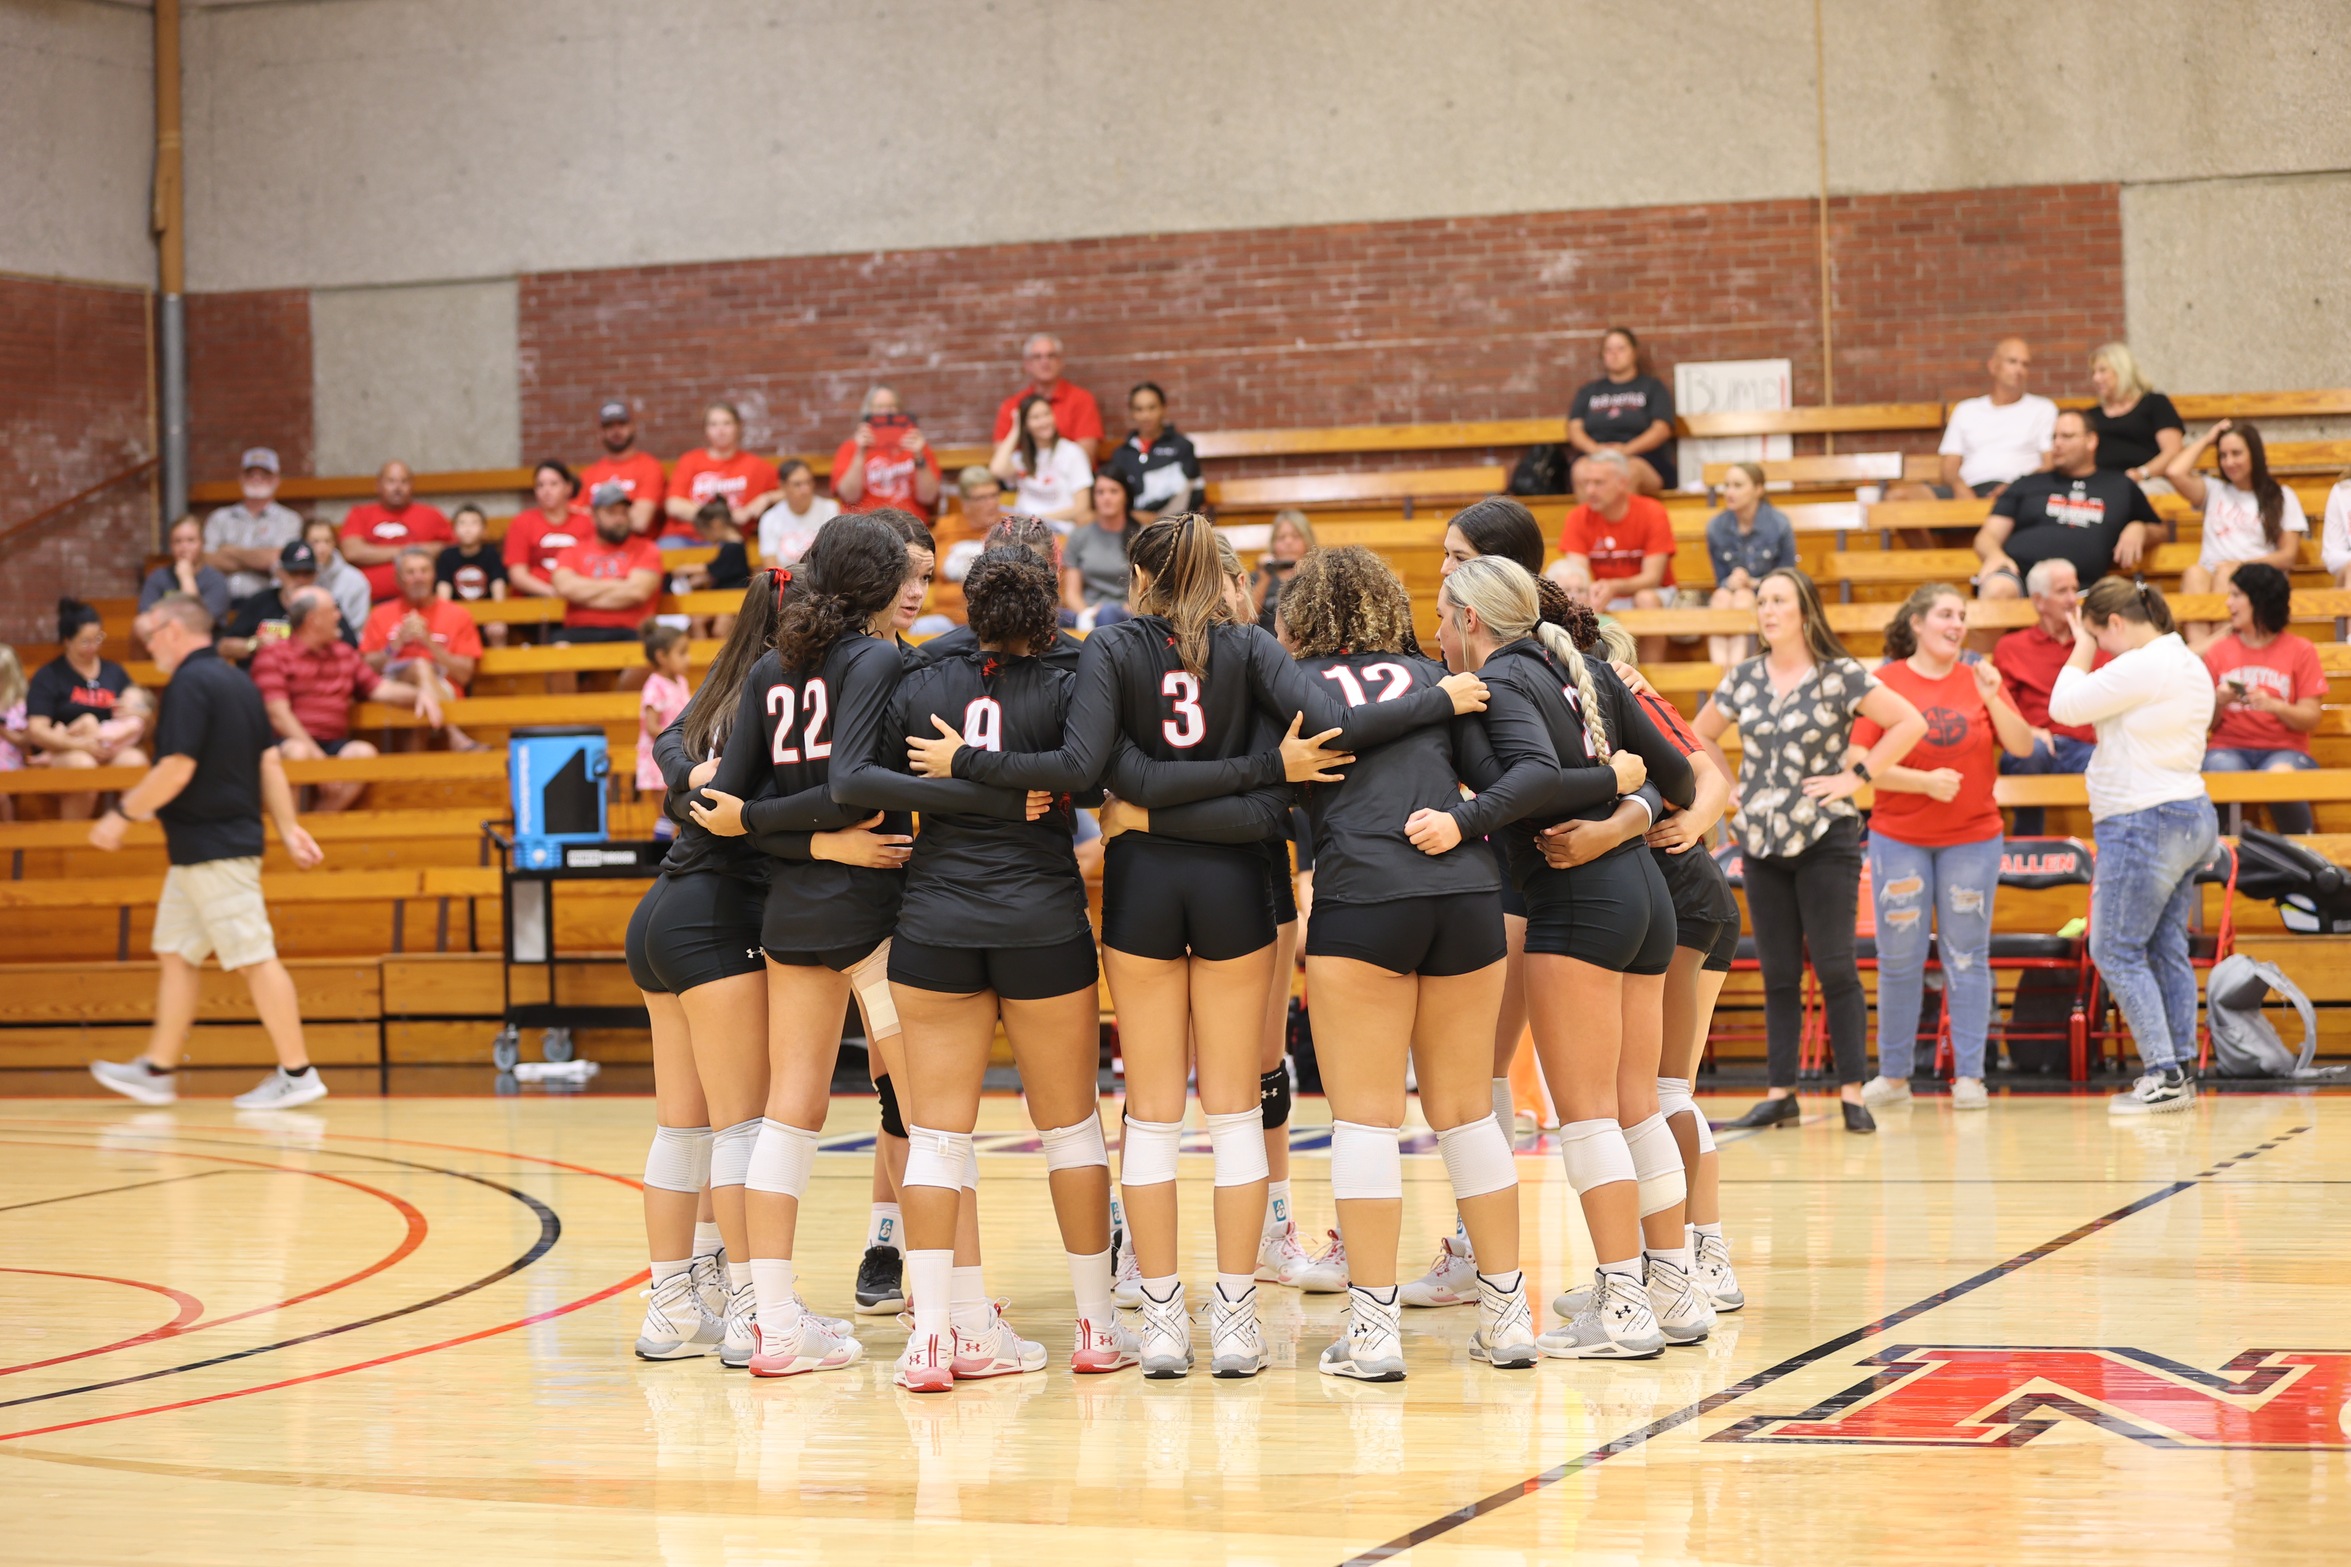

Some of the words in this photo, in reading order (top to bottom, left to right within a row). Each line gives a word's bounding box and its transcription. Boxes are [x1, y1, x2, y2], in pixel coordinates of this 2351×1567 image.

[1161, 669, 1207, 749] 3
[1321, 661, 1414, 709] 12
[766, 676, 832, 766] 22
[963, 695, 1002, 752] 9
[1999, 852, 2077, 875] ALLEN
